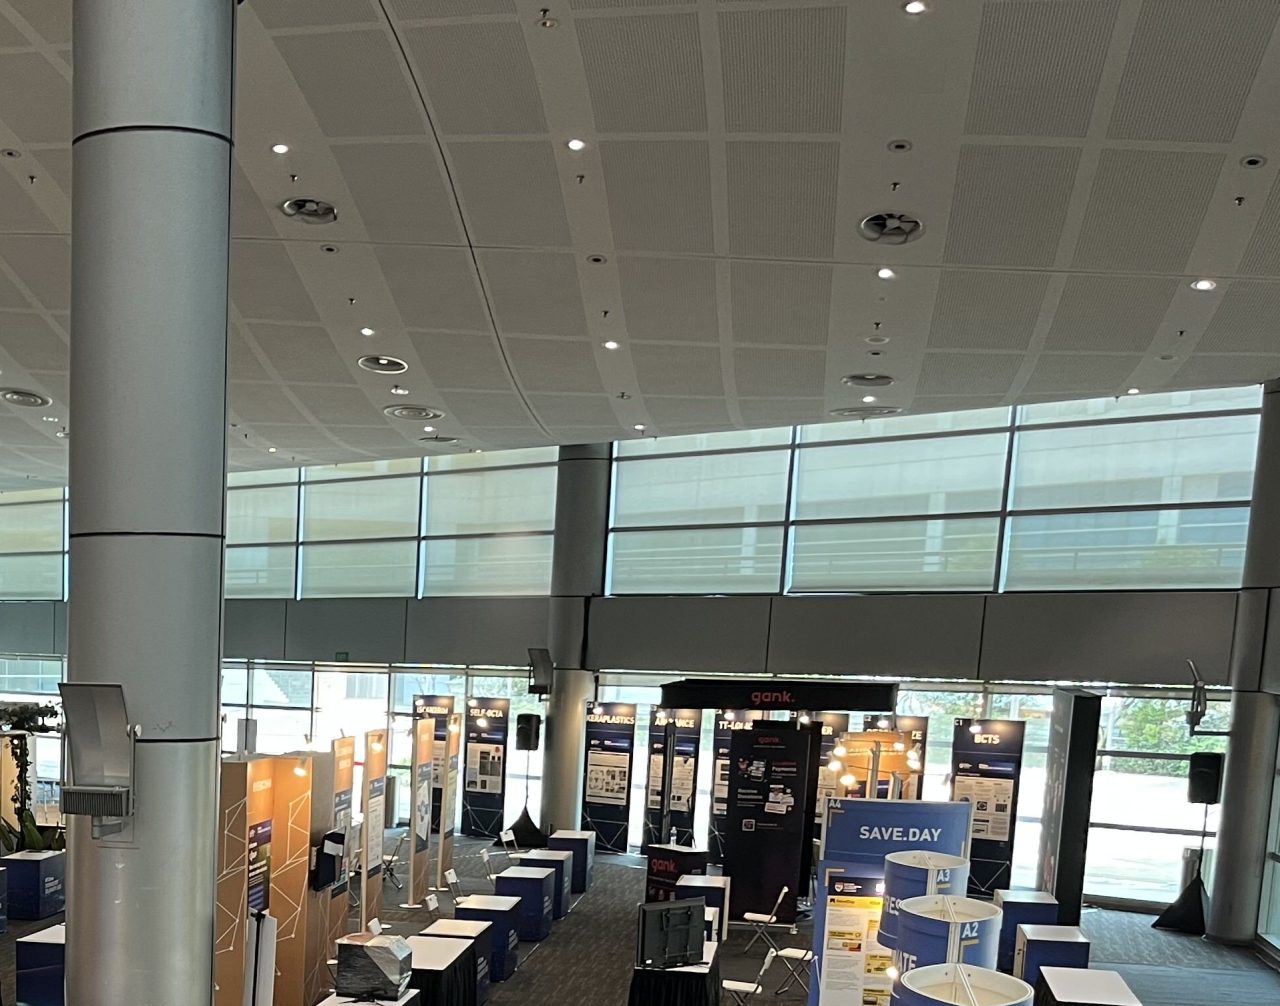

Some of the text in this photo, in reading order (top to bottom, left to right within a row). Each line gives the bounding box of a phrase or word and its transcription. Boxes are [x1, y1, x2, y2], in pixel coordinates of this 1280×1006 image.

[828, 799, 841, 809] A4
[859, 825, 942, 842] SAVE.DAY
[936, 869, 951, 883] A3
[962, 922, 979, 939] A2
